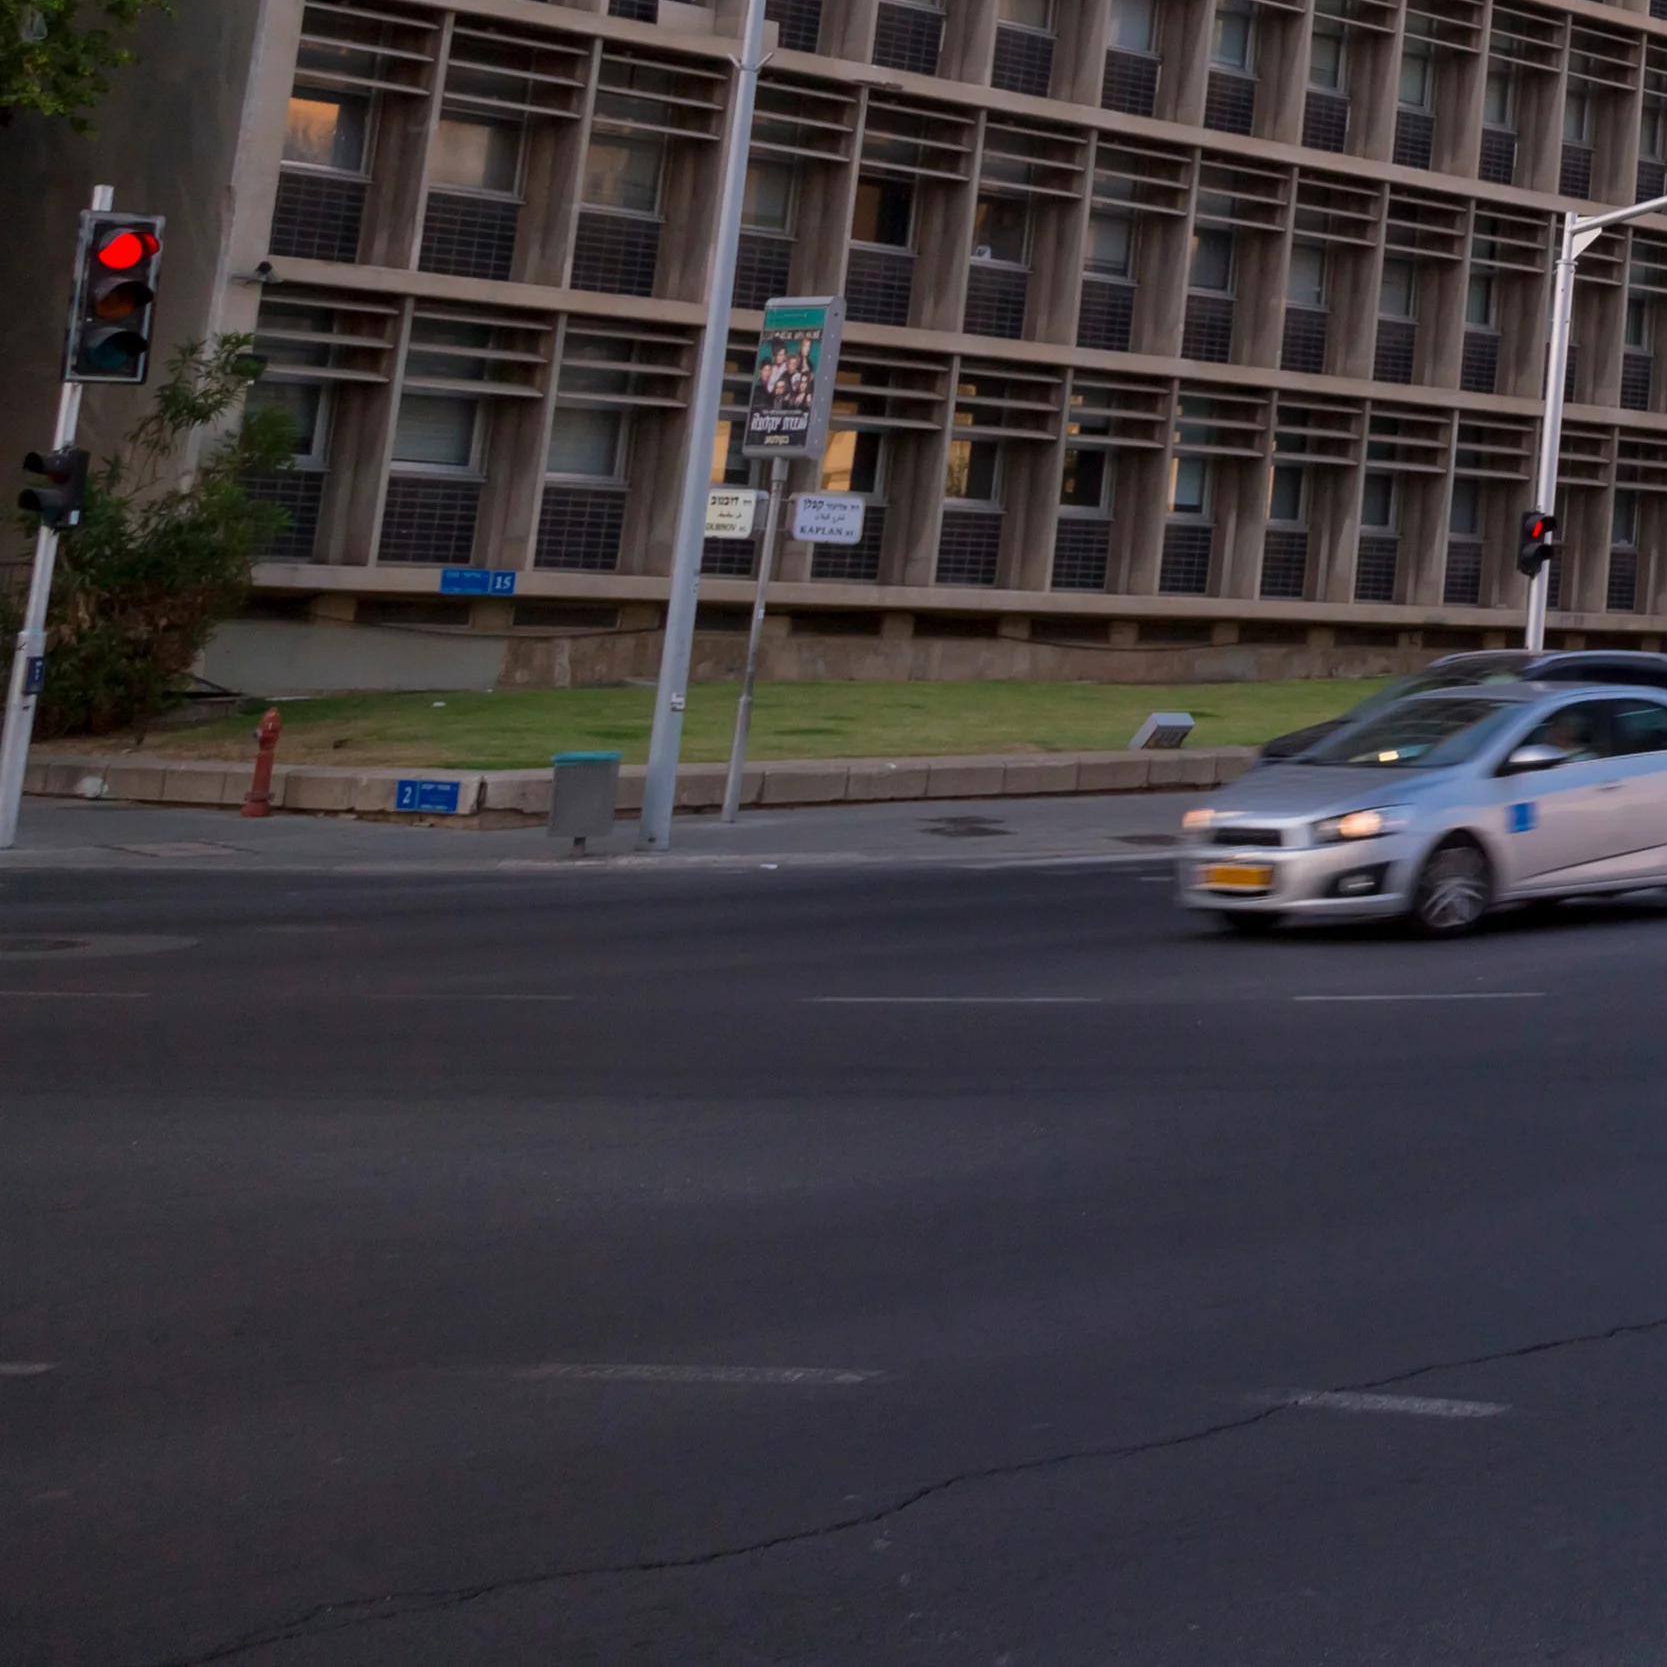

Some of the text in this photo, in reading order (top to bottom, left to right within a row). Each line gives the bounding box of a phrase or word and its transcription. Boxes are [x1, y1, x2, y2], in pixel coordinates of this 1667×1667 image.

[800, 525, 843, 536] KAPLAN
[494, 575, 512, 590] 15
[402, 786, 412, 804] 2
